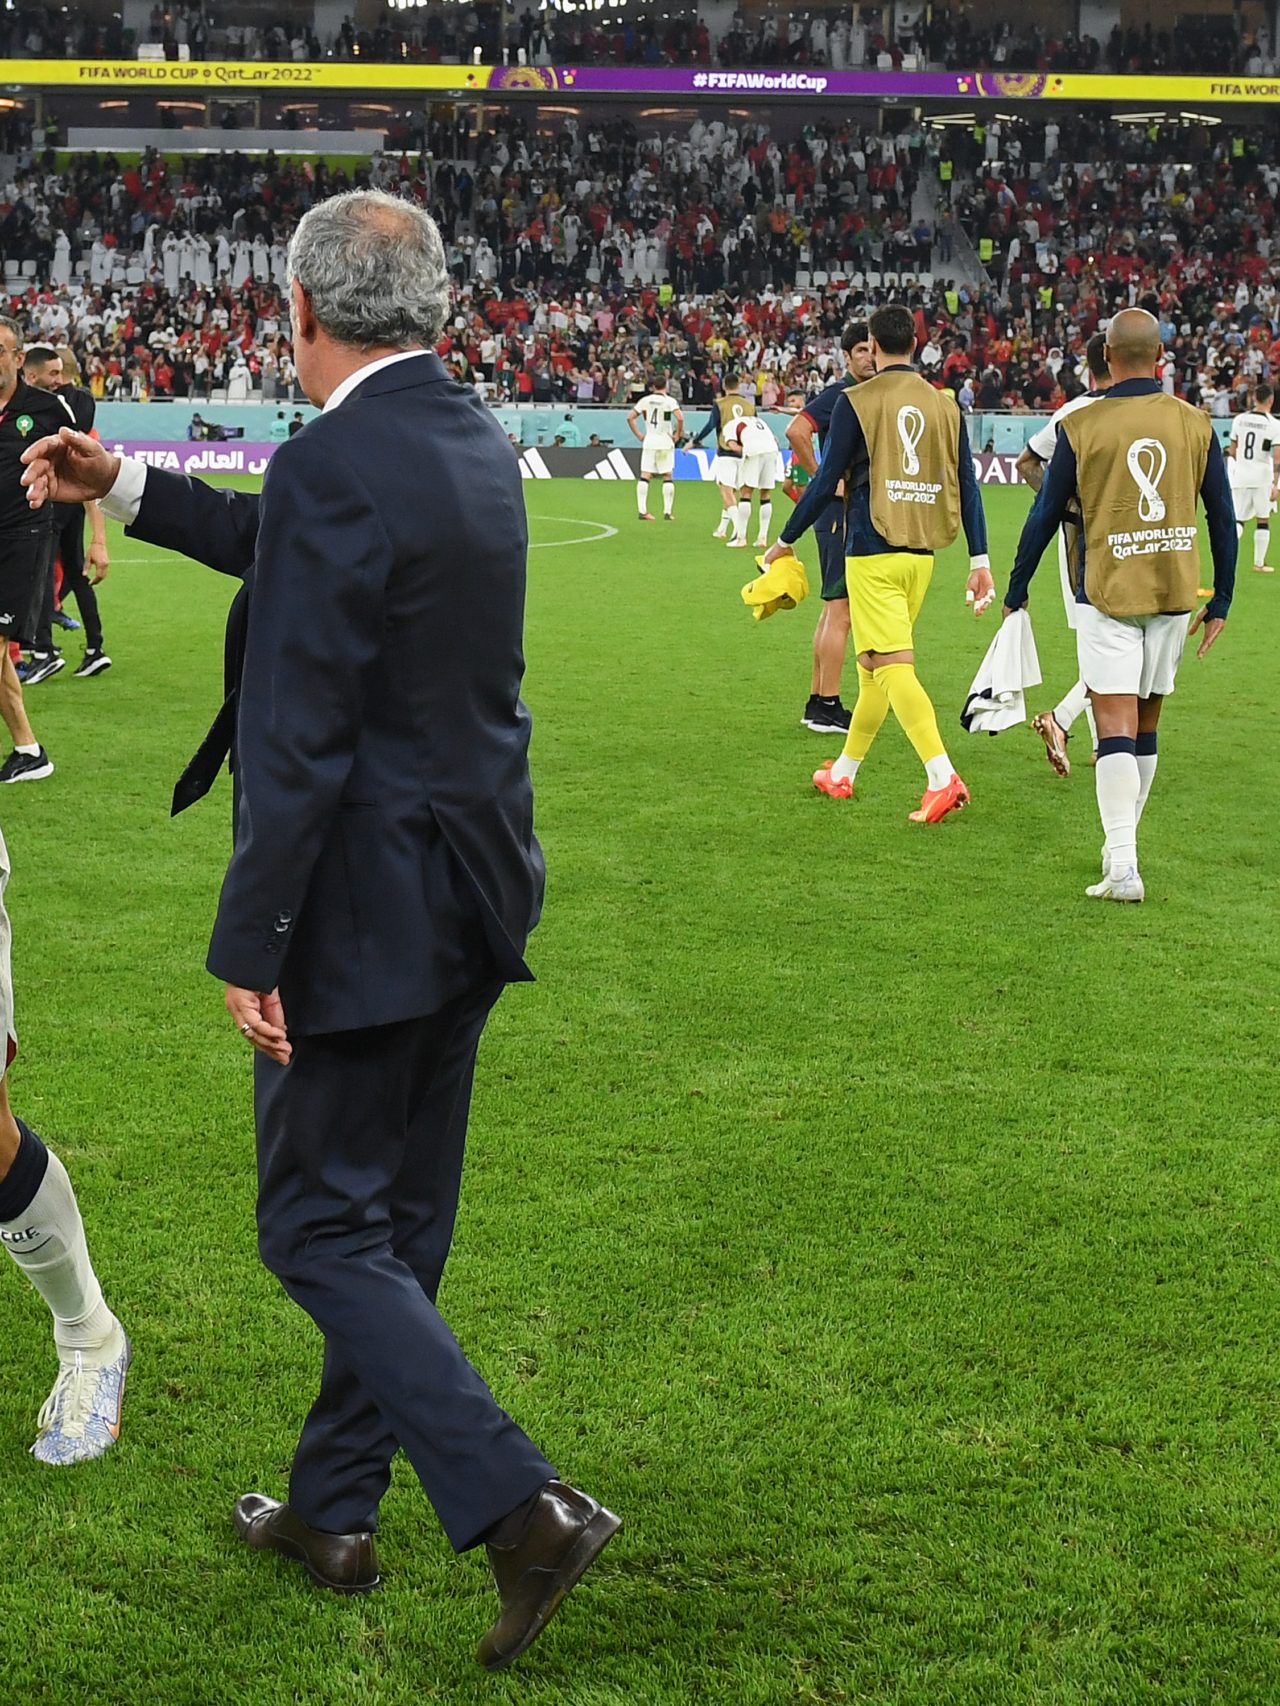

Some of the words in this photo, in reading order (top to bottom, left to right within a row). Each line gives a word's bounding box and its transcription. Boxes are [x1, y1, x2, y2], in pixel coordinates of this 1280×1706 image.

[79, 67, 110, 78] FIFA
[113, 67, 167, 79] WORLD
[170, 67, 199, 79] CUP
[693, 72, 828, 93] #FIFAWorldCup
[1210, 83, 1242, 95] FIFA
[650, 407, 658, 429] 4
[1244, 431, 1256, 460] 8
[184, 450, 244, 474] العالم
[1108, 532, 1133, 546] FIFA
[1132, 527, 1175, 542] WORLD
[1174, 526, 1197, 538] CUP
